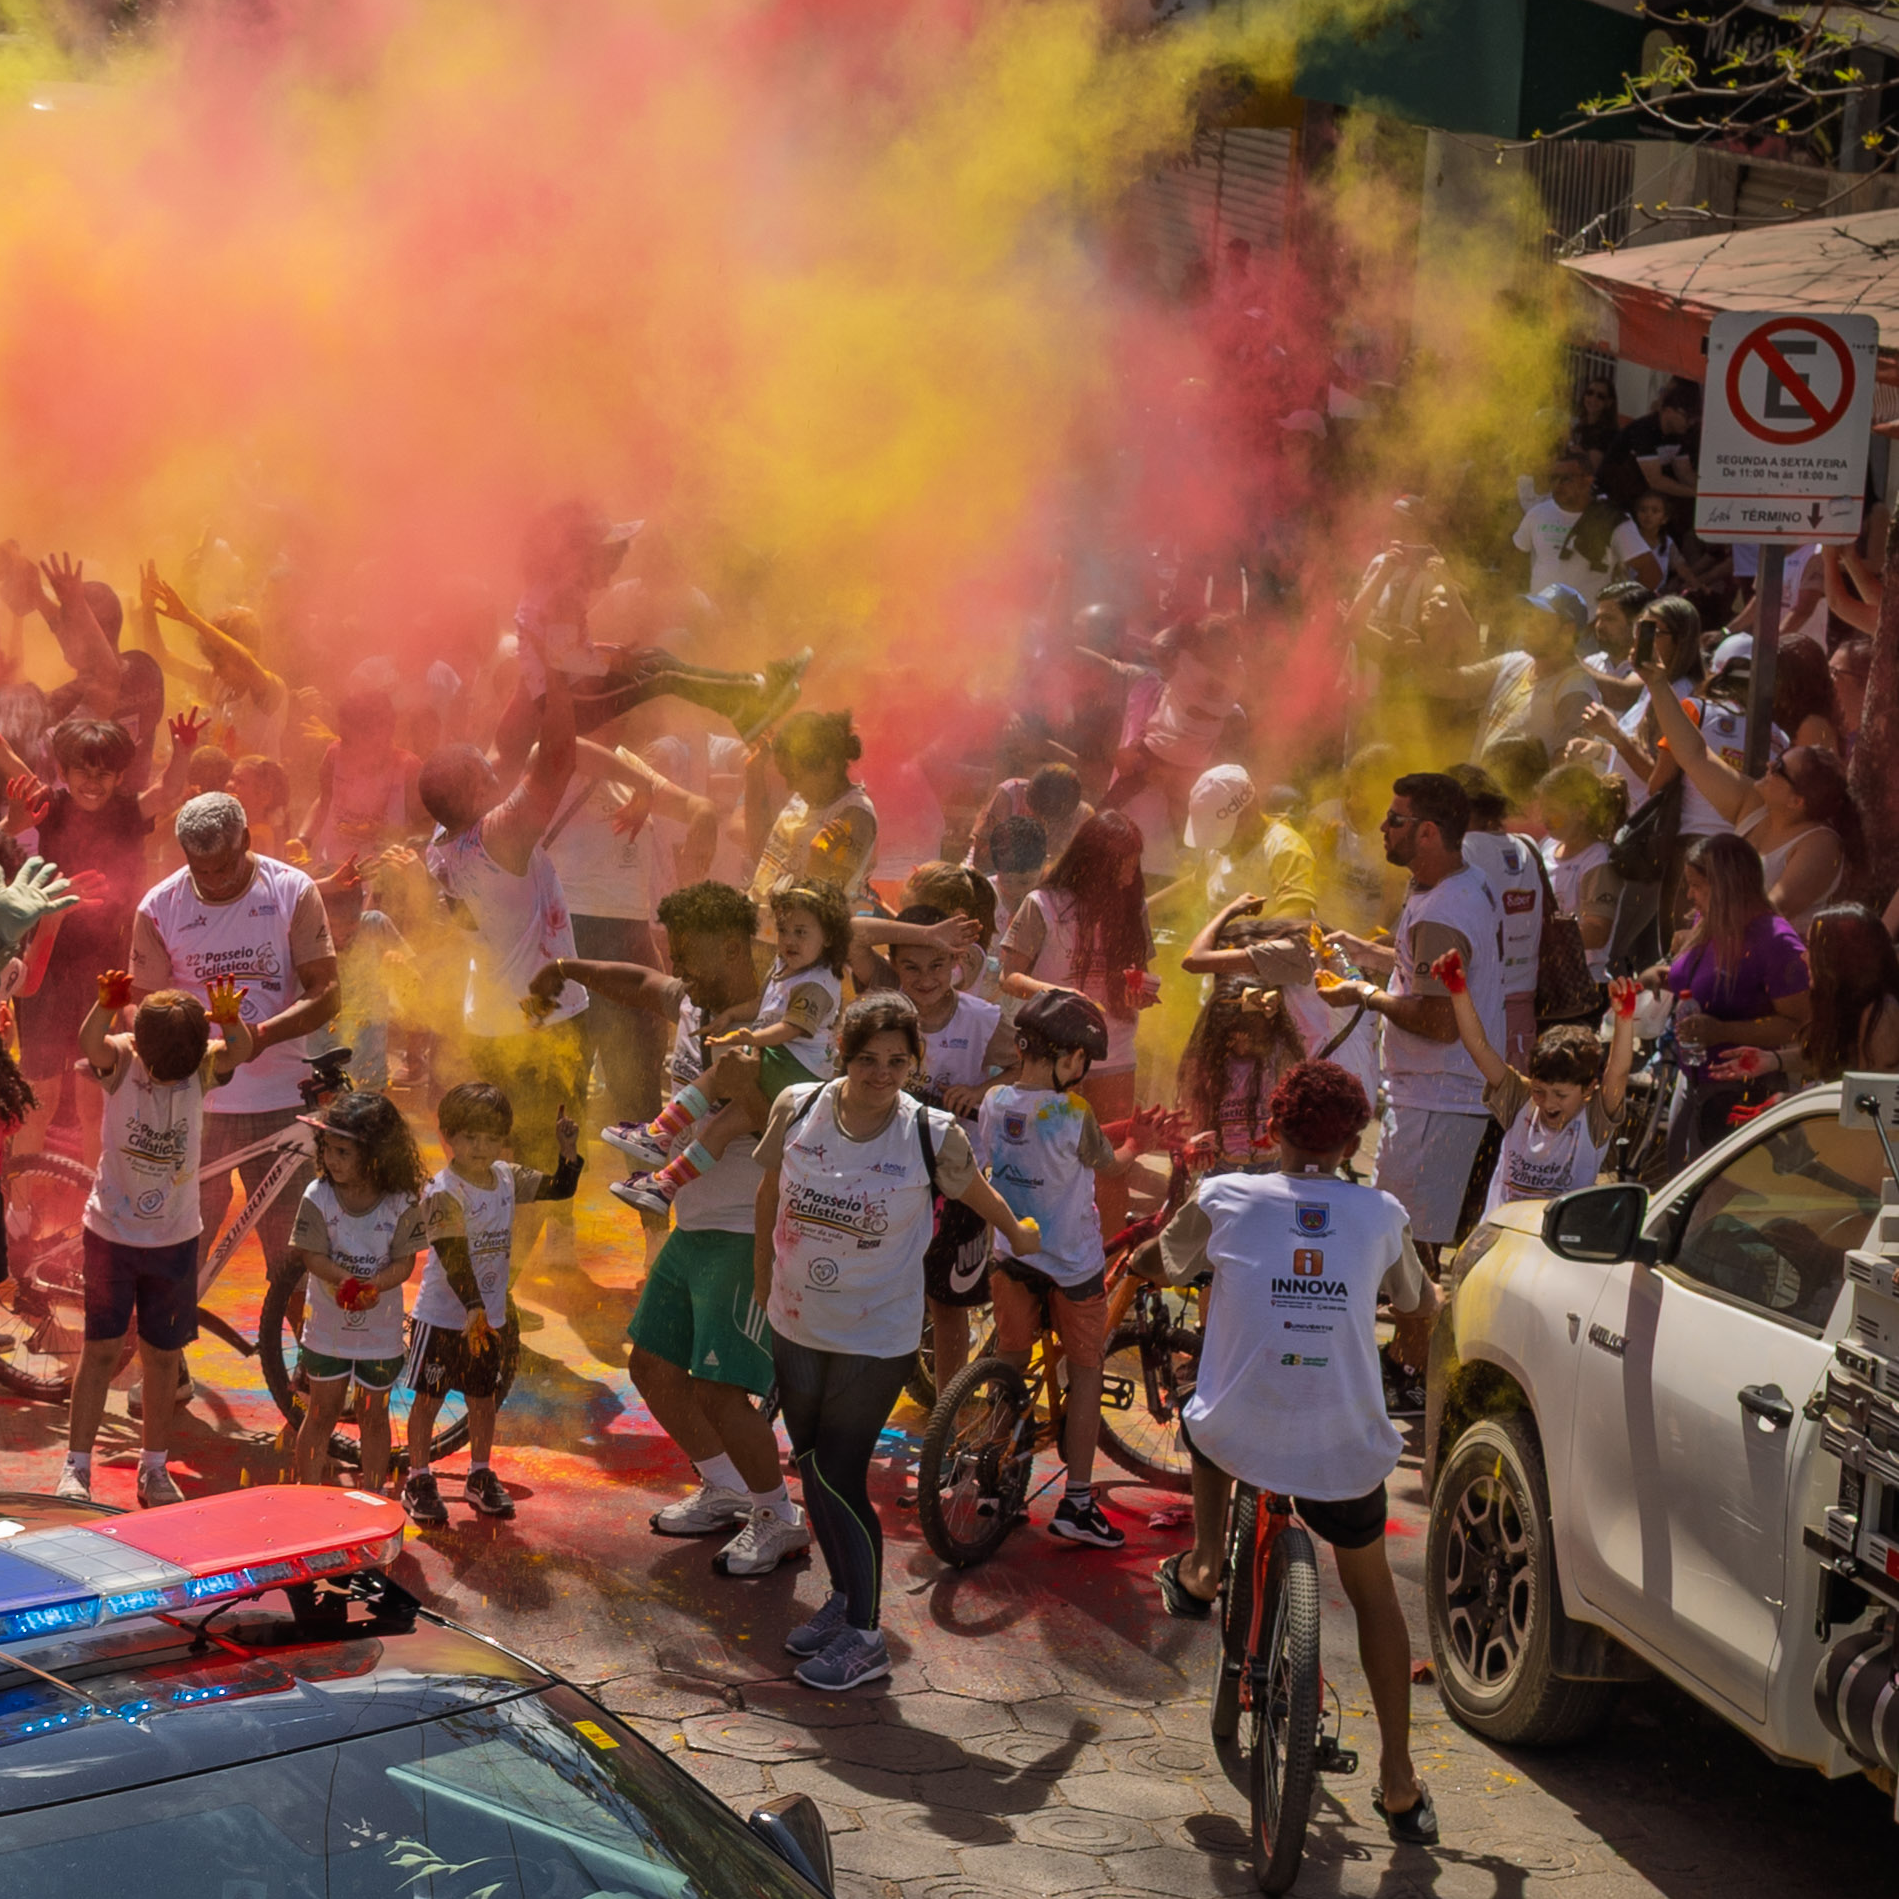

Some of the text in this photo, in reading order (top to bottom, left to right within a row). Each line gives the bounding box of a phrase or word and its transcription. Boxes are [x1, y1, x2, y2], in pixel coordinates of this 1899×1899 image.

[1716, 454, 1848, 469] SEGUNDA A SEXTA FEIRA
[1722, 468, 1736, 478] De
[1740, 468, 1764, 479] 11:00
[1768, 468, 1780, 479] hs
[1798, 470, 1823, 481] 18:00
[1826, 471, 1838, 482] hs
[1741, 507, 1802, 524] TÉRMINO
[204, 946, 254, 965] Passeio
[194, 958, 251, 979] Ciclístico
[802, 1186, 863, 1213] Passeio
[788, 1198, 853, 1224] Ciclístico
[335, 1251, 377, 1265] Passeio
[1271, 1278, 1349, 1297] INNOVA
